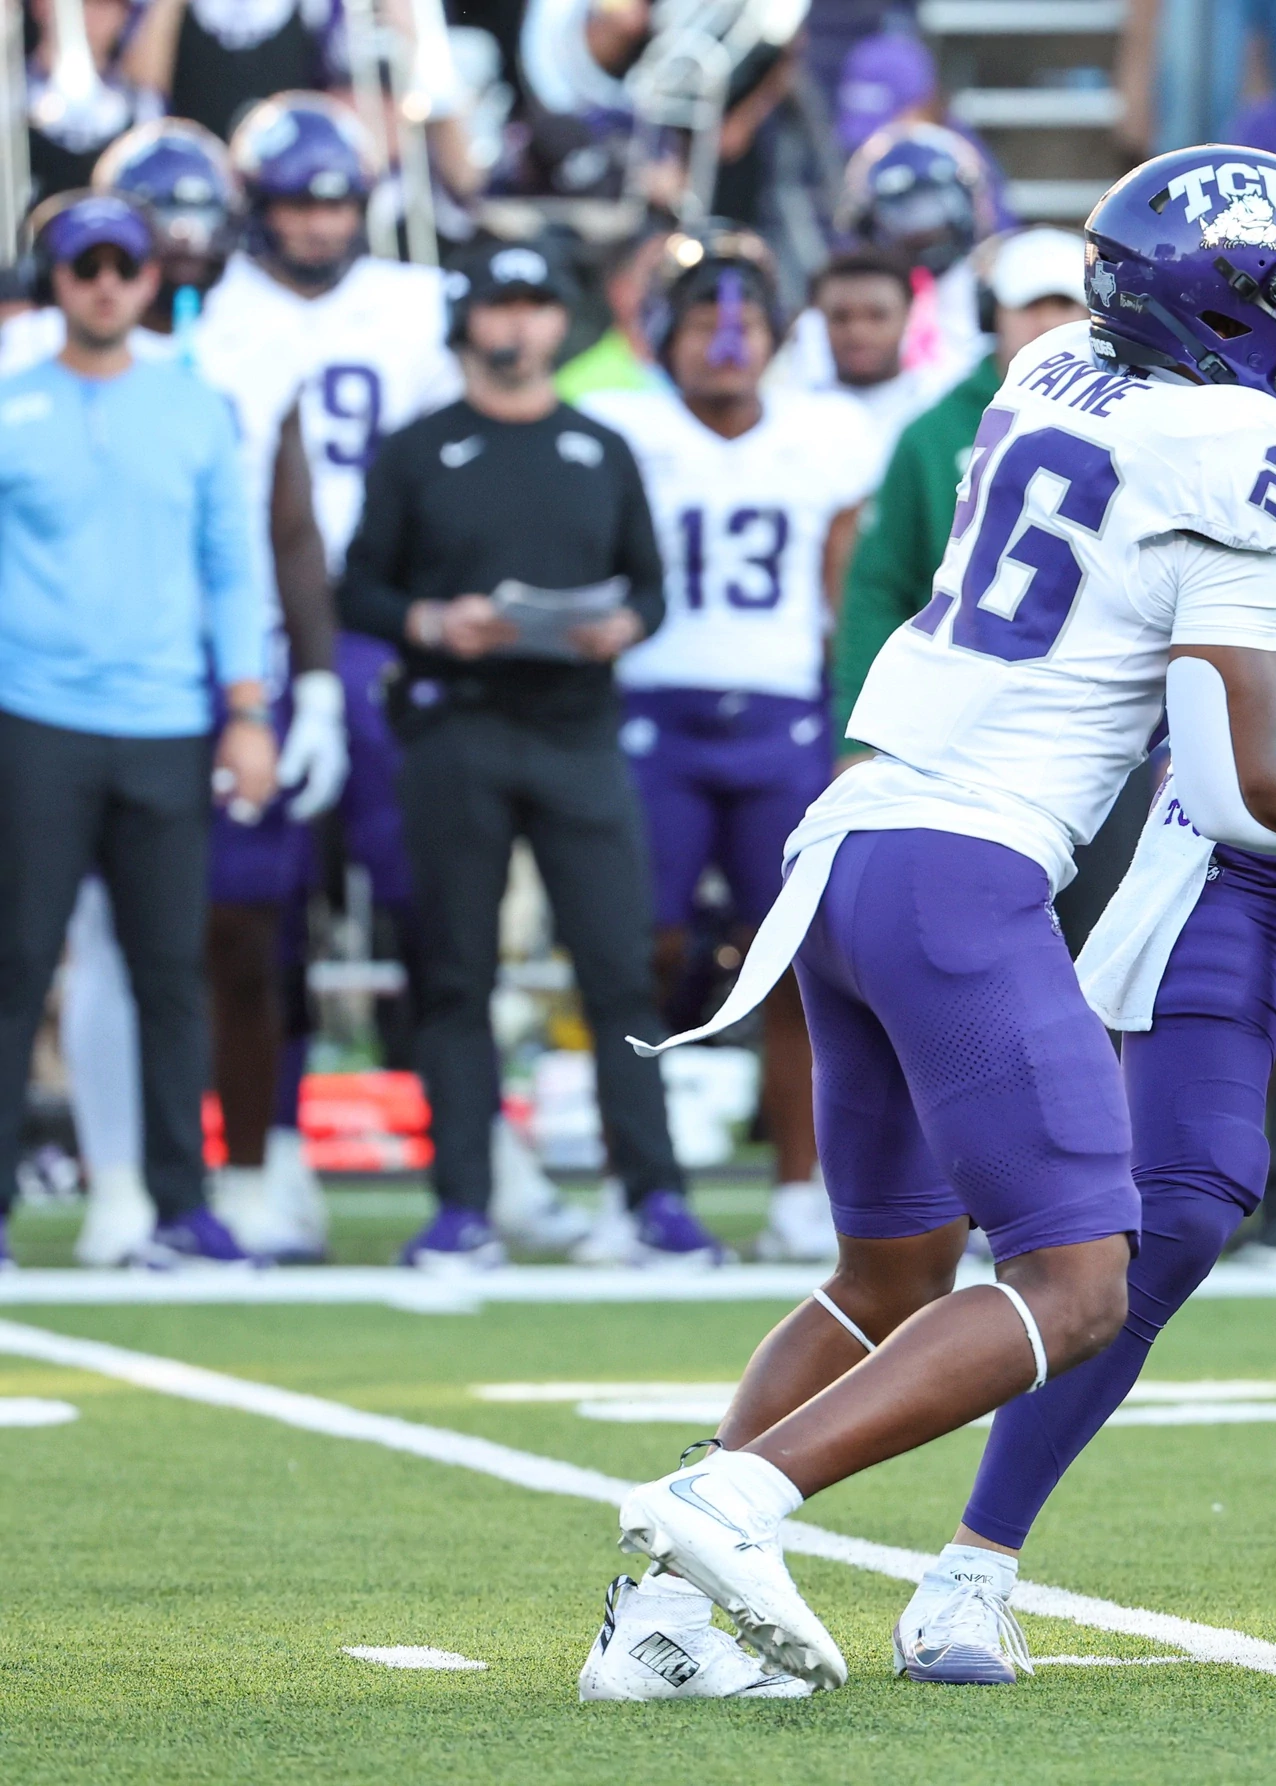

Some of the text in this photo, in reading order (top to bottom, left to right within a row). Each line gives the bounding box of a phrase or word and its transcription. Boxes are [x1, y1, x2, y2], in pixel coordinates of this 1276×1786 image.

[323, 365, 380, 468] 9
[1017, 351, 1154, 418] PAYNE
[679, 507, 790, 612] 13
[629, 1631, 700, 1688] NIKE
